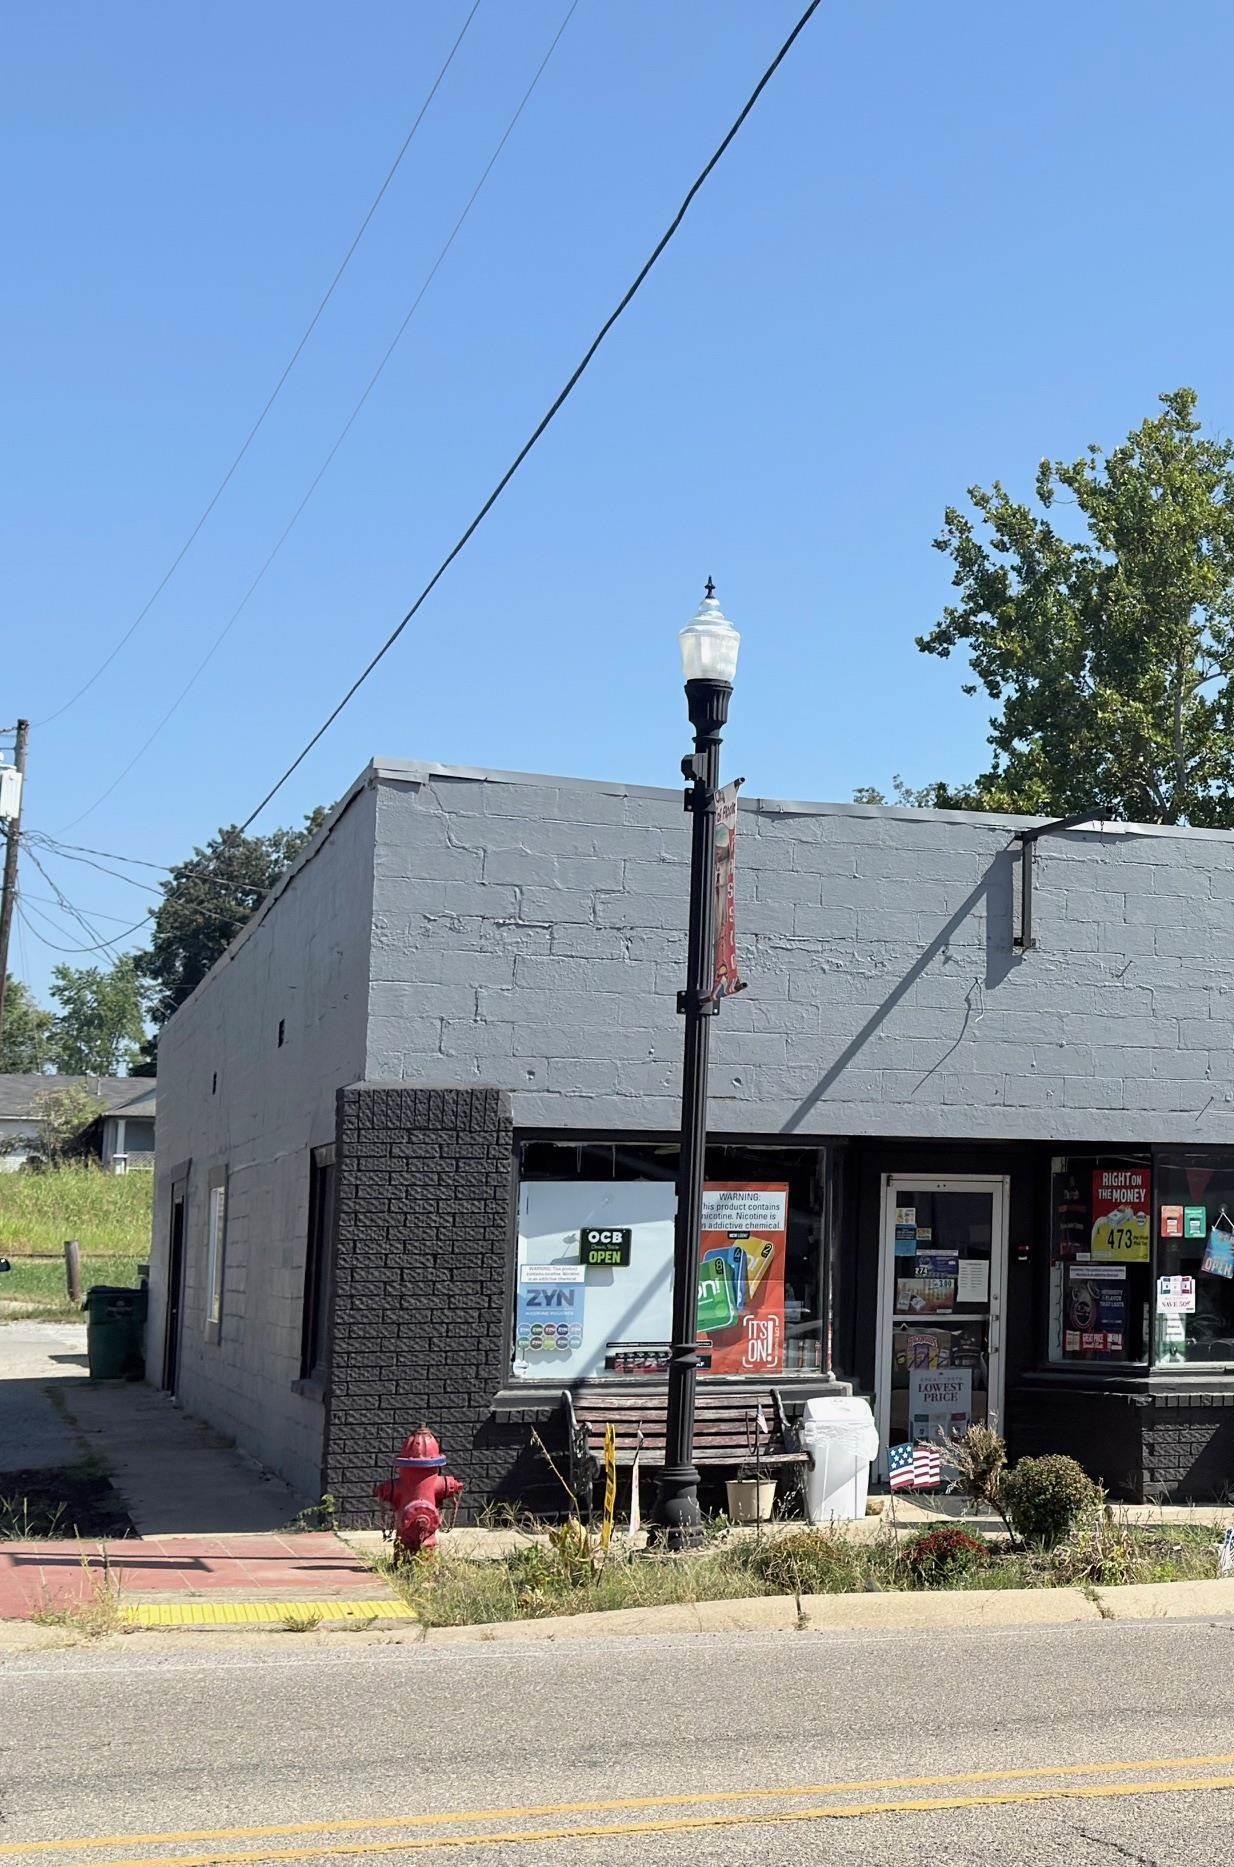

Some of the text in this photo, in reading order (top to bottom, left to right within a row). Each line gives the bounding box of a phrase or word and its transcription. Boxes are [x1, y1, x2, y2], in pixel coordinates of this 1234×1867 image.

[1103, 1172, 1142, 1186] RIGHT ON
[719, 1193, 760, 1201] WARNING:
[1098, 1189, 1146, 1203] THE MONEY
[716, 1203, 745, 1212] product
[588, 1231, 622, 1243] OCB
[589, 1251, 620, 1263] OPEN
[526, 1289, 575, 1306] ZYN
[918, 1383, 963, 1392] LOWEST
[924, 1392, 958, 1402] PRICE
